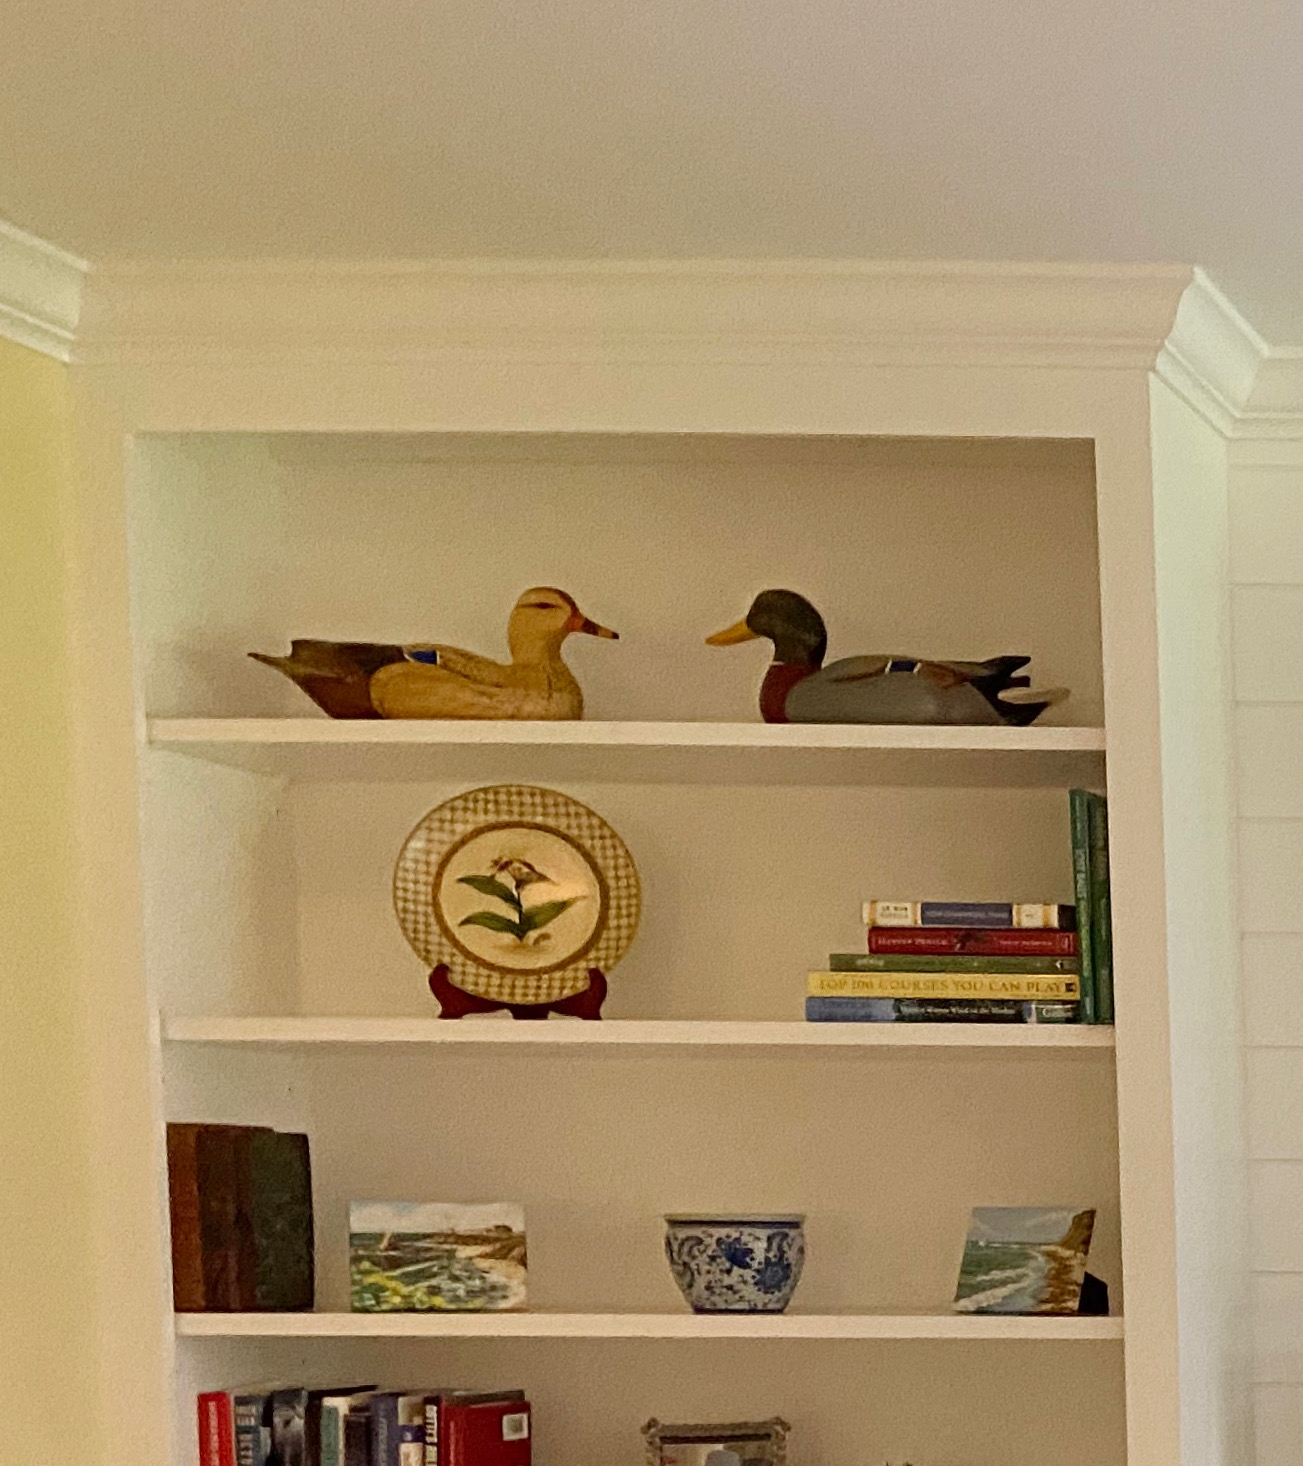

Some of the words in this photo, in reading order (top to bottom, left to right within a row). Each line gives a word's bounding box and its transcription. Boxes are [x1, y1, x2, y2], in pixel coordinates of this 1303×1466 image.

[878, 979, 950, 992] COURSES
[954, 980, 982, 992] YOU
[988, 980, 1021, 992] CAN
[1027, 981, 1061, 992] PLAY
